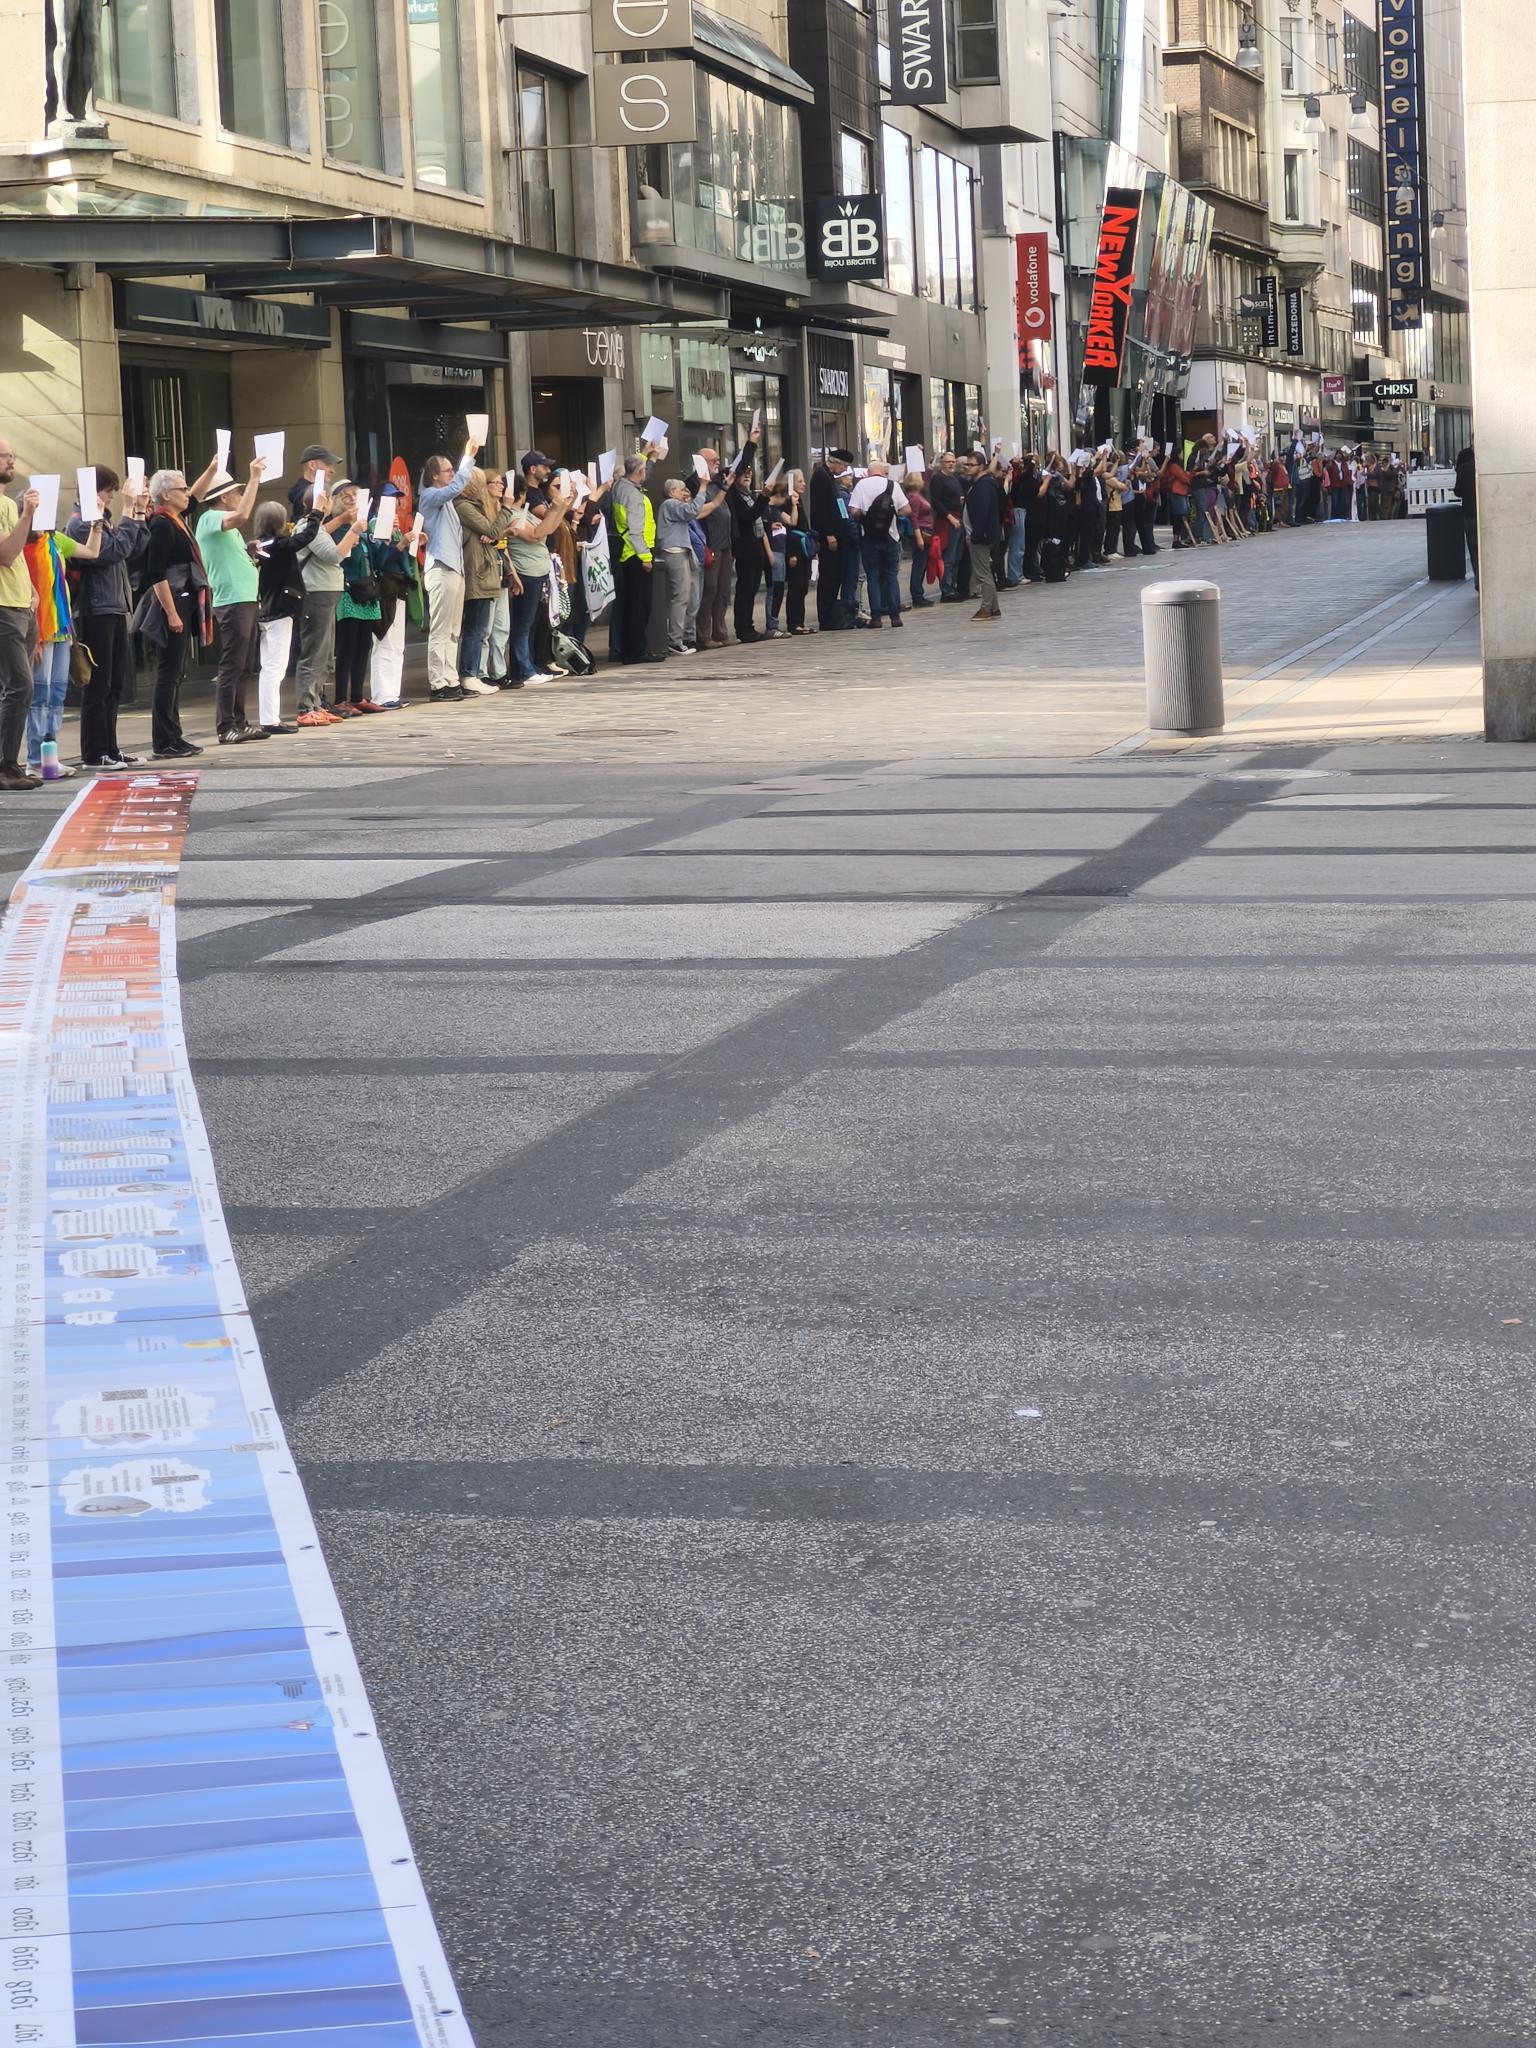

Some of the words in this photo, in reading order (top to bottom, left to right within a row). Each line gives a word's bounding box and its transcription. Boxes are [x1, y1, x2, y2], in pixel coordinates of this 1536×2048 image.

[824, 259, 845, 269] BIJOU
[846, 257, 878, 267] BRIGITTE
[1027, 245, 1039, 305] vodafone
[1289, 291, 1300, 352] CALZEDONIA
[819, 366, 849, 398] SWAROVSKI
[1374, 383, 1415, 397] CHRIST
[12, 1609, 33, 1625] 1931
[11, 1632, 32, 1648] 1930
[11, 1697, 35, 1719] 1927
[7, 1726, 35, 1745] 1926
[10, 1782, 35, 1802] 1924
[12, 1811, 38, 1833] 1923
[12, 1840, 38, 1864] 1922
[12, 1907, 39, 1932] 1920
[12, 1946, 39, 1971] 1919
[5, 1980, 39, 2010] 1918
[15, 2022, 44, 2043] 1917
